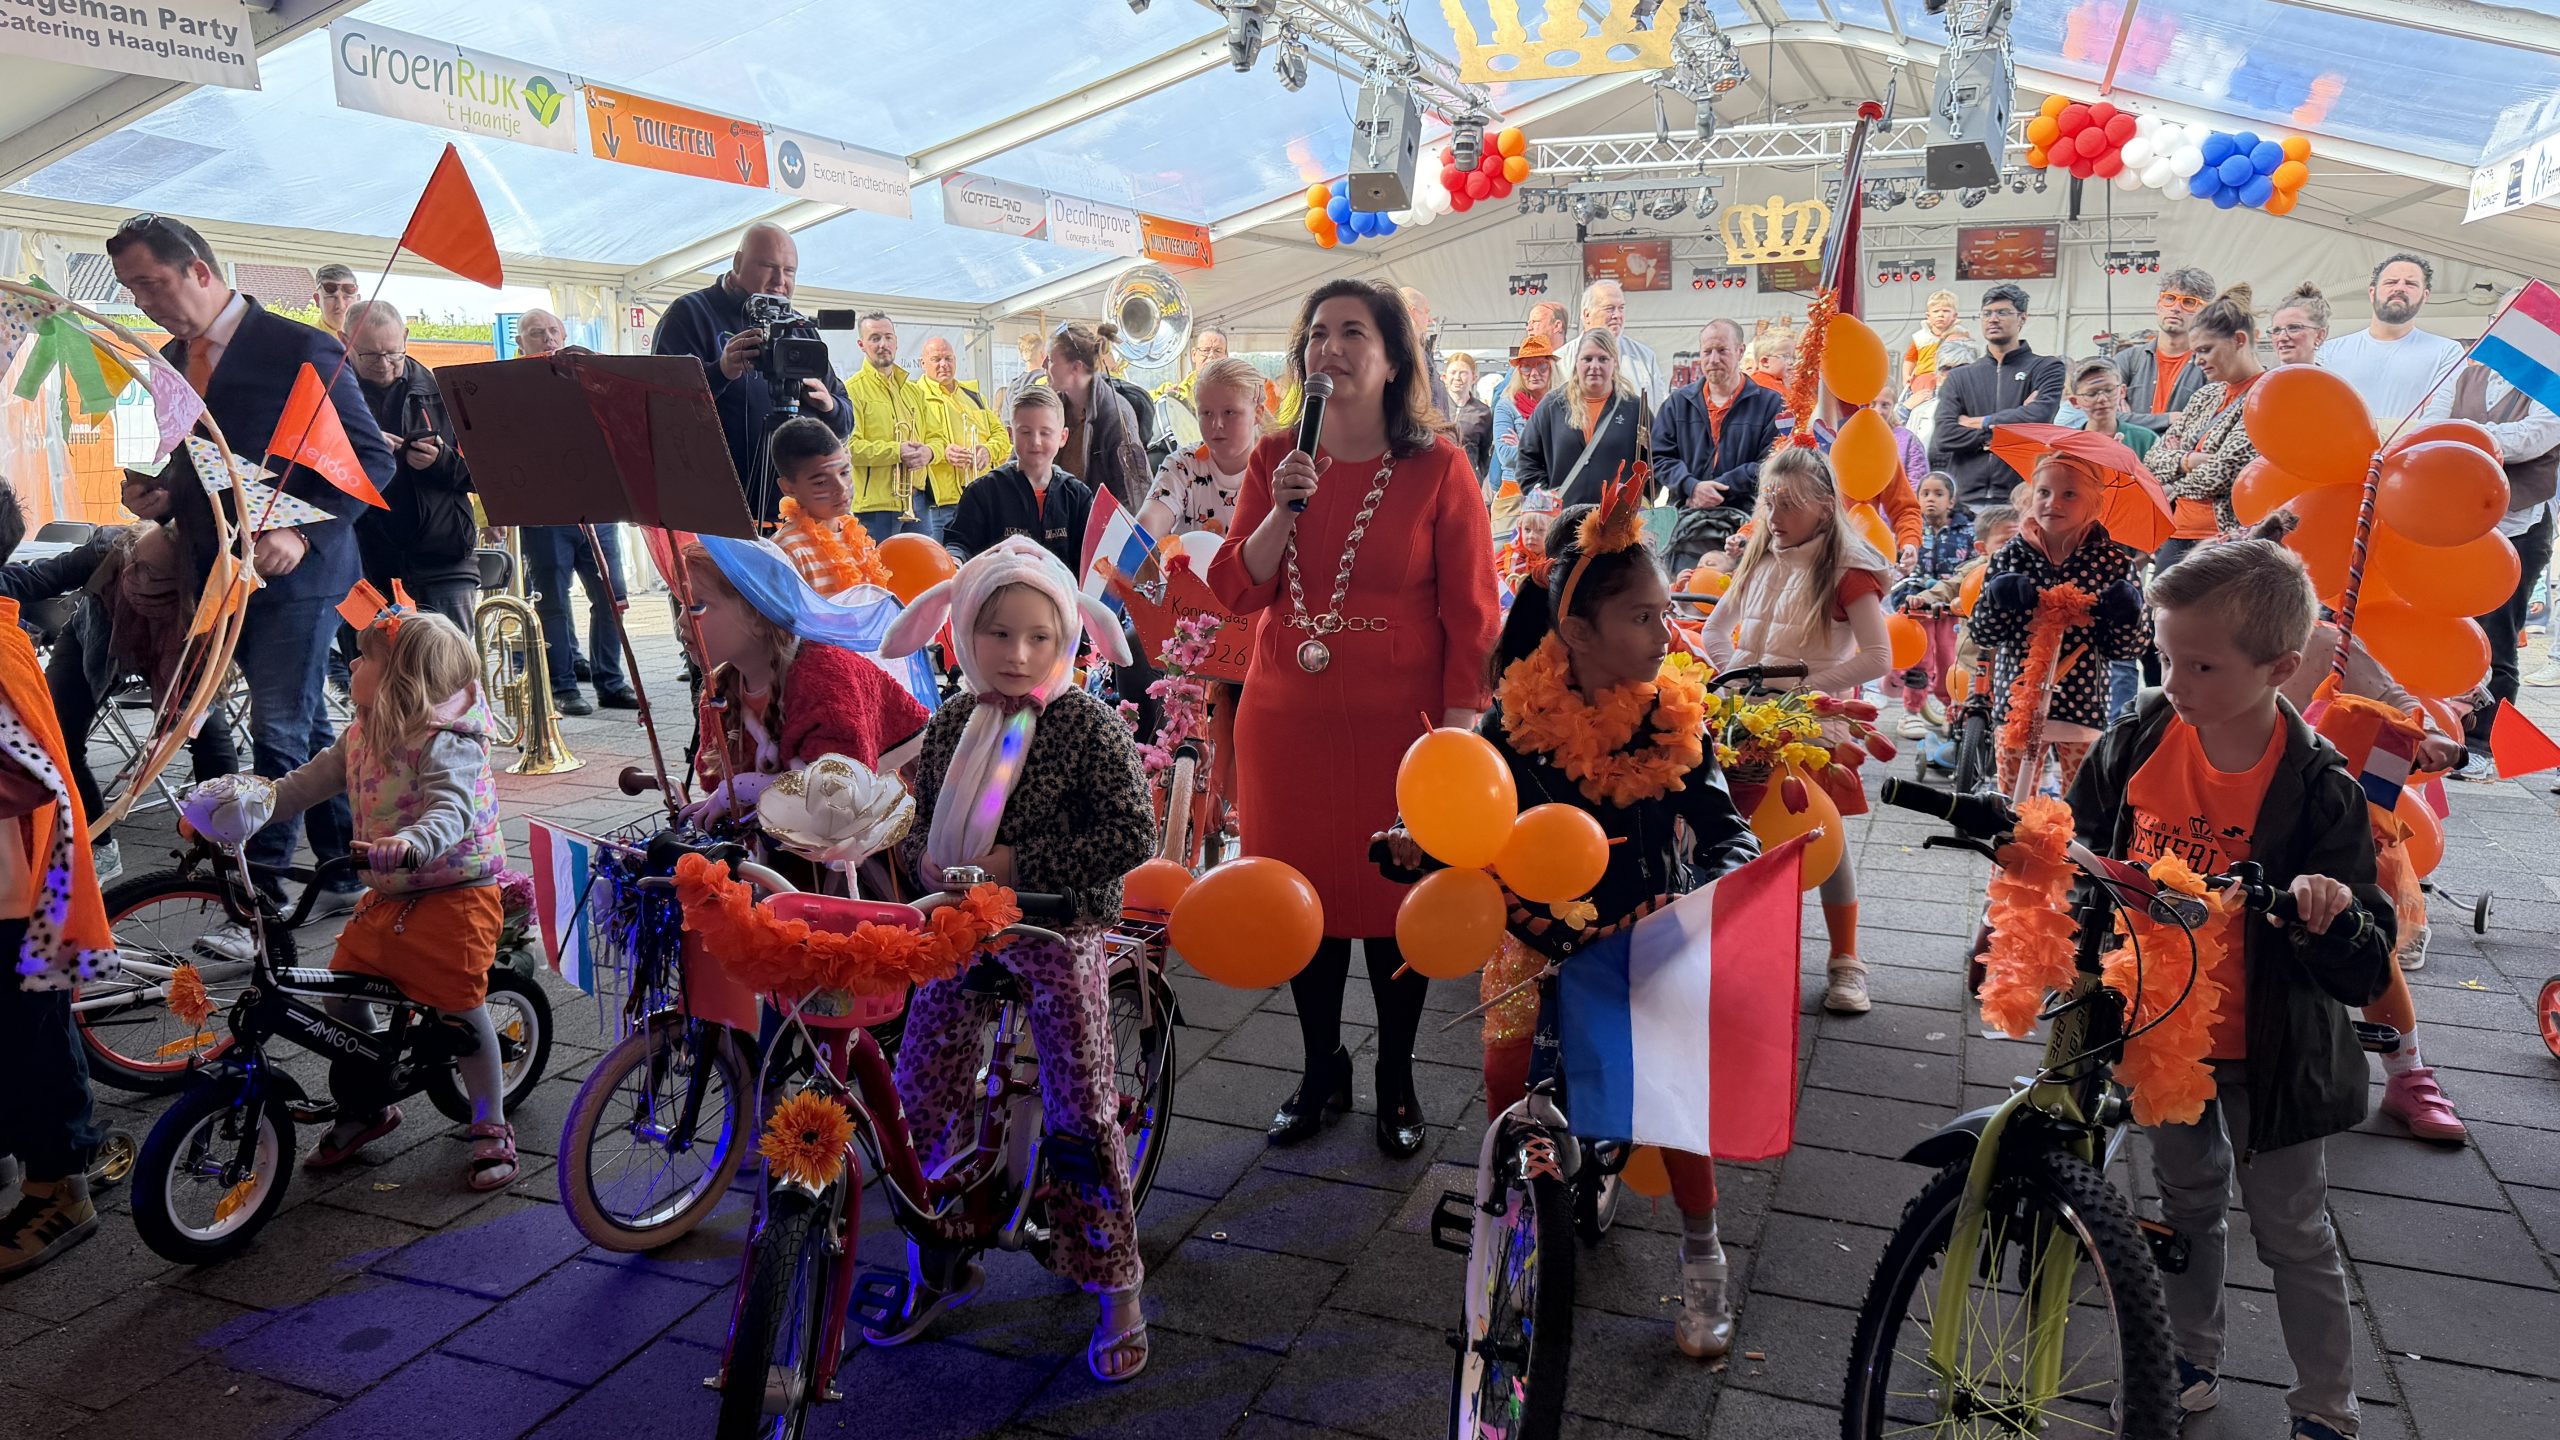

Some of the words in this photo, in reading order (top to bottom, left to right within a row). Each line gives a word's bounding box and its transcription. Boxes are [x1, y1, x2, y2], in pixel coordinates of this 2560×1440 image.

[158, 7, 239, 47] Party
[108, 28, 245, 66] Haaglanden
[443, 98, 454, 121] 't
[460, 105, 521, 137] Haantje
[632, 115, 716, 158] TOILETTEN
[813, 162, 846, 185] Excent
[848, 170, 908, 198] Tandtechniek
[960, 190, 1022, 213] KORTELAND
[1054, 199, 1131, 238] DecoImprove
[1065, 230, 1090, 247] Concepts
[304, 1019, 360, 1054] AMIGO
